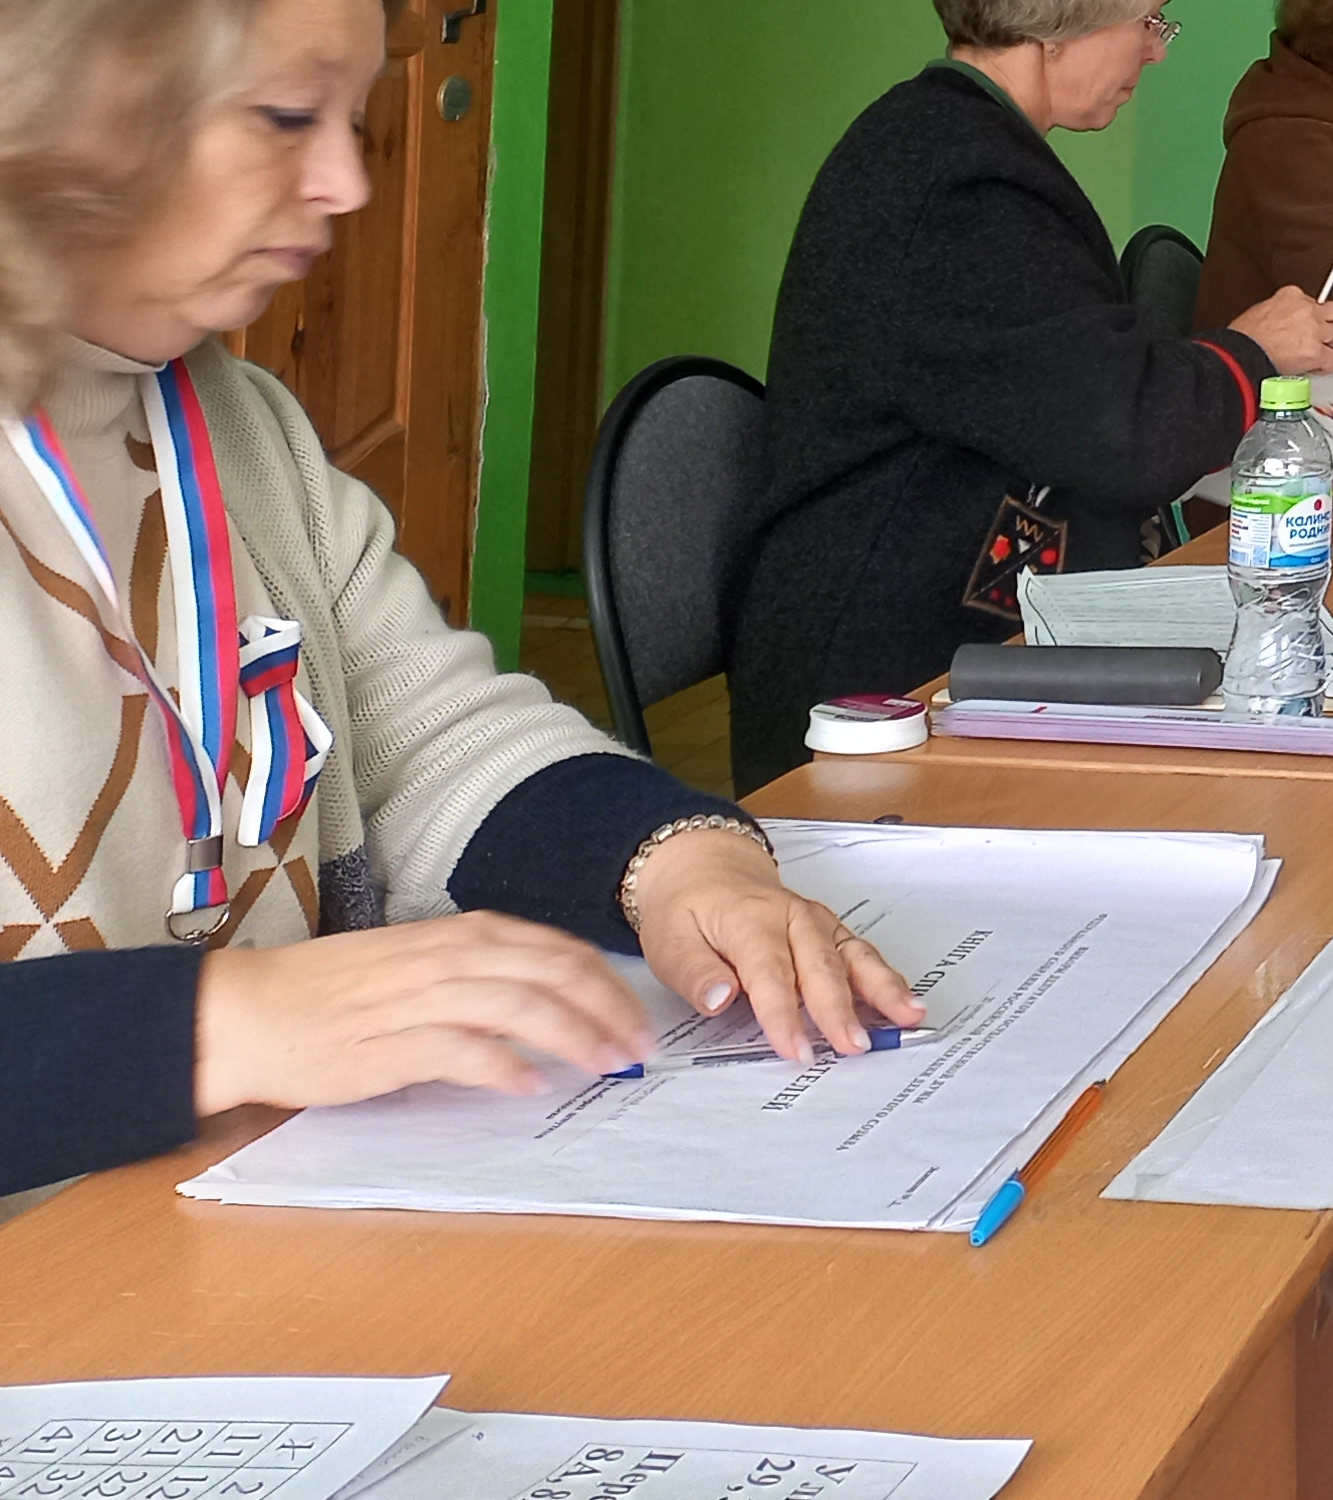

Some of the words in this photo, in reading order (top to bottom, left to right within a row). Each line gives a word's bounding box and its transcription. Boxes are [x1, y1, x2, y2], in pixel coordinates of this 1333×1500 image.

[934, 929, 993, 968] КНИГА
[875, 1077, 925, 1118] ДЕВЯТОГО
[912, 1079, 945, 1104] ДУМЫ
[836, 1118, 880, 1151] СОЗЫВА
[19, 1425, 74, 1455] 41
[80, 1427, 143, 1455] 31
[142, 1427, 204, 1456] 21
[203, 1432, 262, 1457] 11
[18, 1469, 86, 1498] 32
[82, 1470, 148, 1499] 22
[146, 1475, 209, 1500] 12
[220, 1481, 264, 1496] 2
